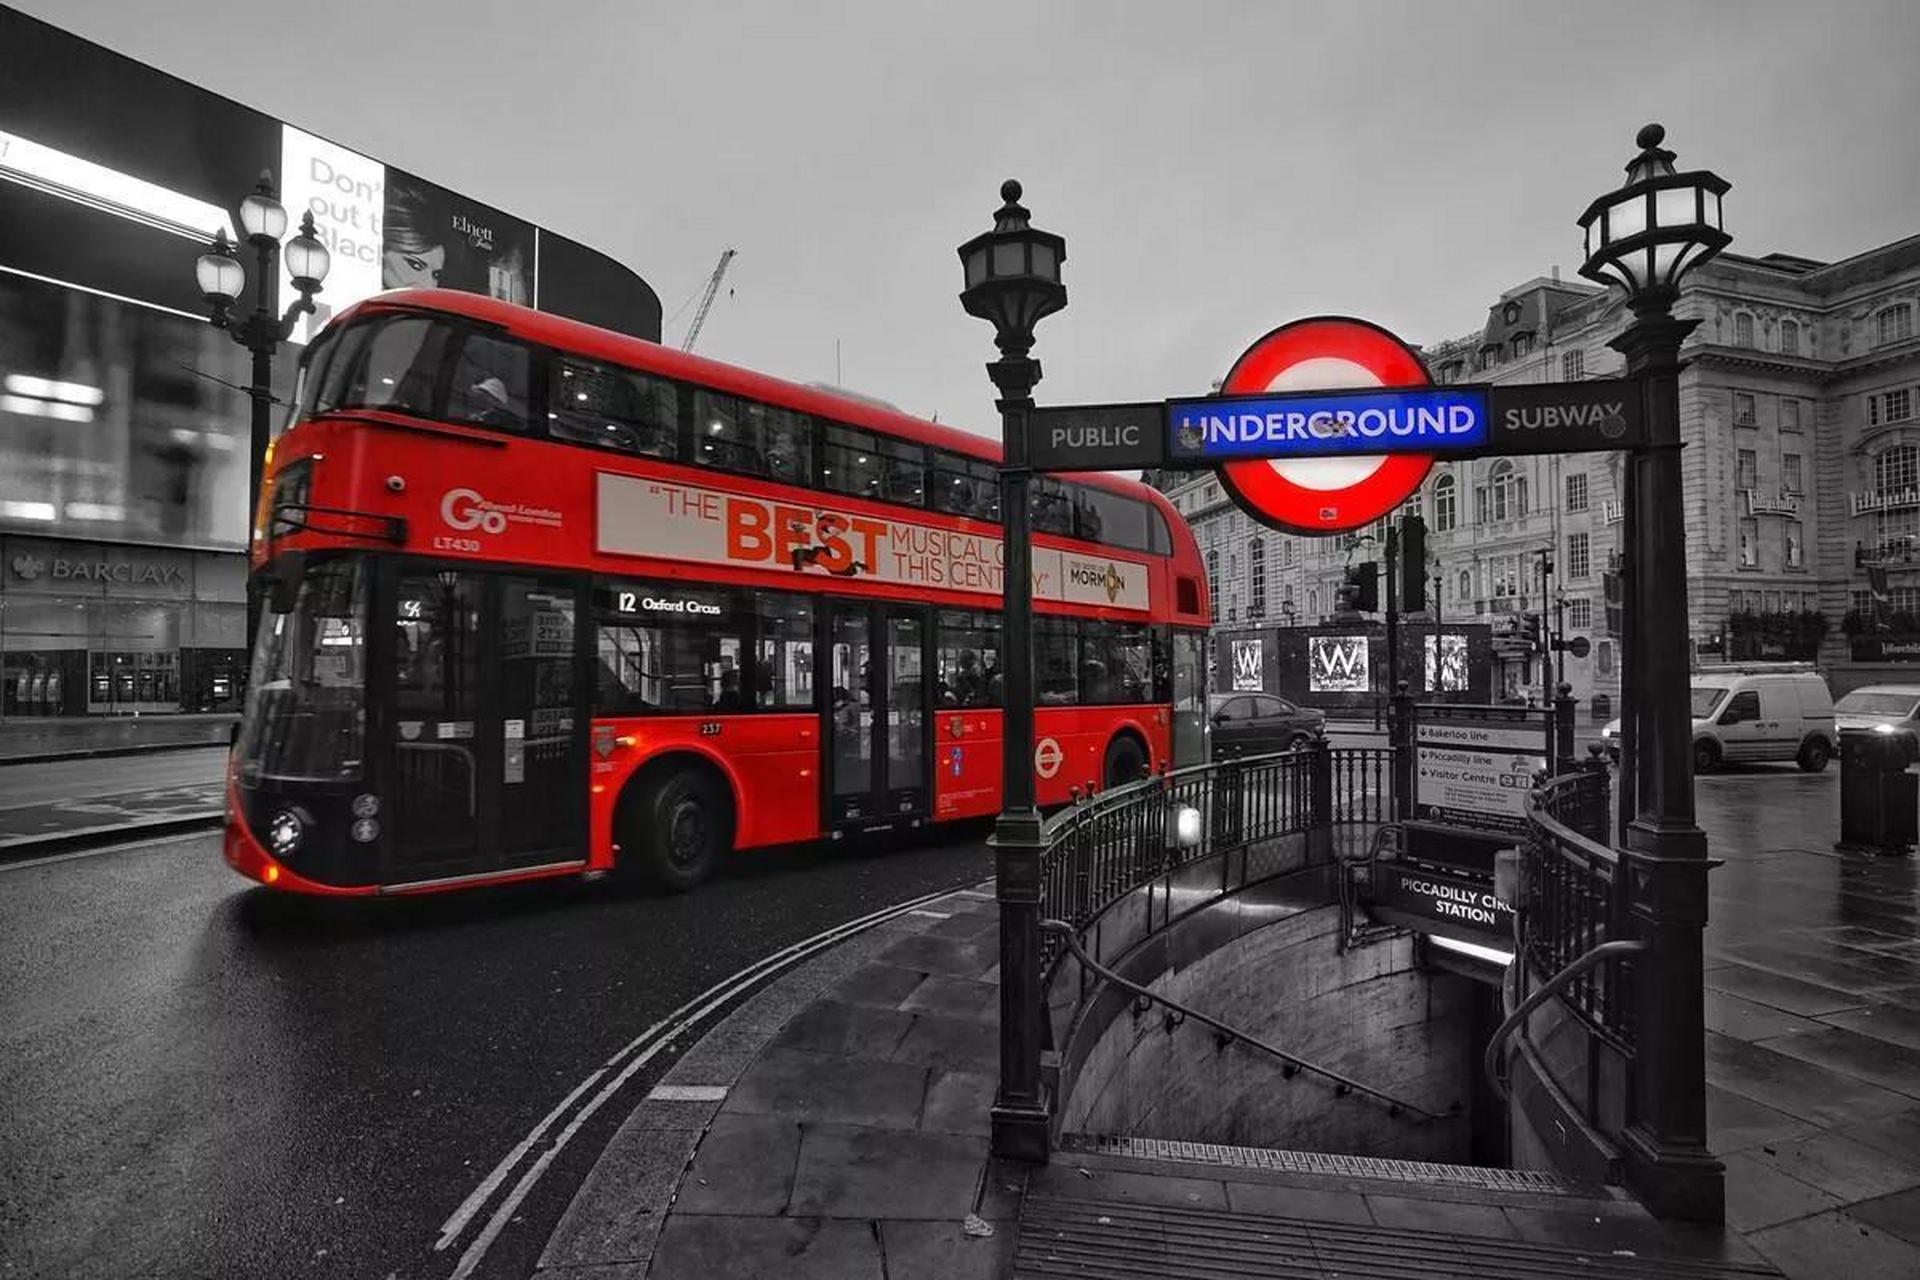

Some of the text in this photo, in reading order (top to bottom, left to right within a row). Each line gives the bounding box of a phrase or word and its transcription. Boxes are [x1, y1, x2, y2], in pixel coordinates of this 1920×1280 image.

[309, 196, 360, 229] out
[1183, 405, 1475, 443] UNDERGROUND
[1505, 402, 1623, 430] SUBWAY
[1052, 425, 1139, 449] PUBLIC
[441, 488, 507, 534] Go
[727, 497, 888, 576] BEST
[891, 526, 989, 564] MUSICAL
[893, 552, 943, 580] THIS
[1070, 567, 1126, 591] MORMON
[619, 593, 721, 615] 12 Oxford Circus
[1319, 643, 1358, 677] W
[1428, 728, 1488, 741] Bakerloo line
[1429, 750, 1492, 765] Piccadilly line
[1430, 768, 1459, 780] Visitor
[1462, 771, 1496, 785] Centre
[1401, 877, 1477, 904] PICCADILLY
[1435, 900, 1495, 925] STATION
